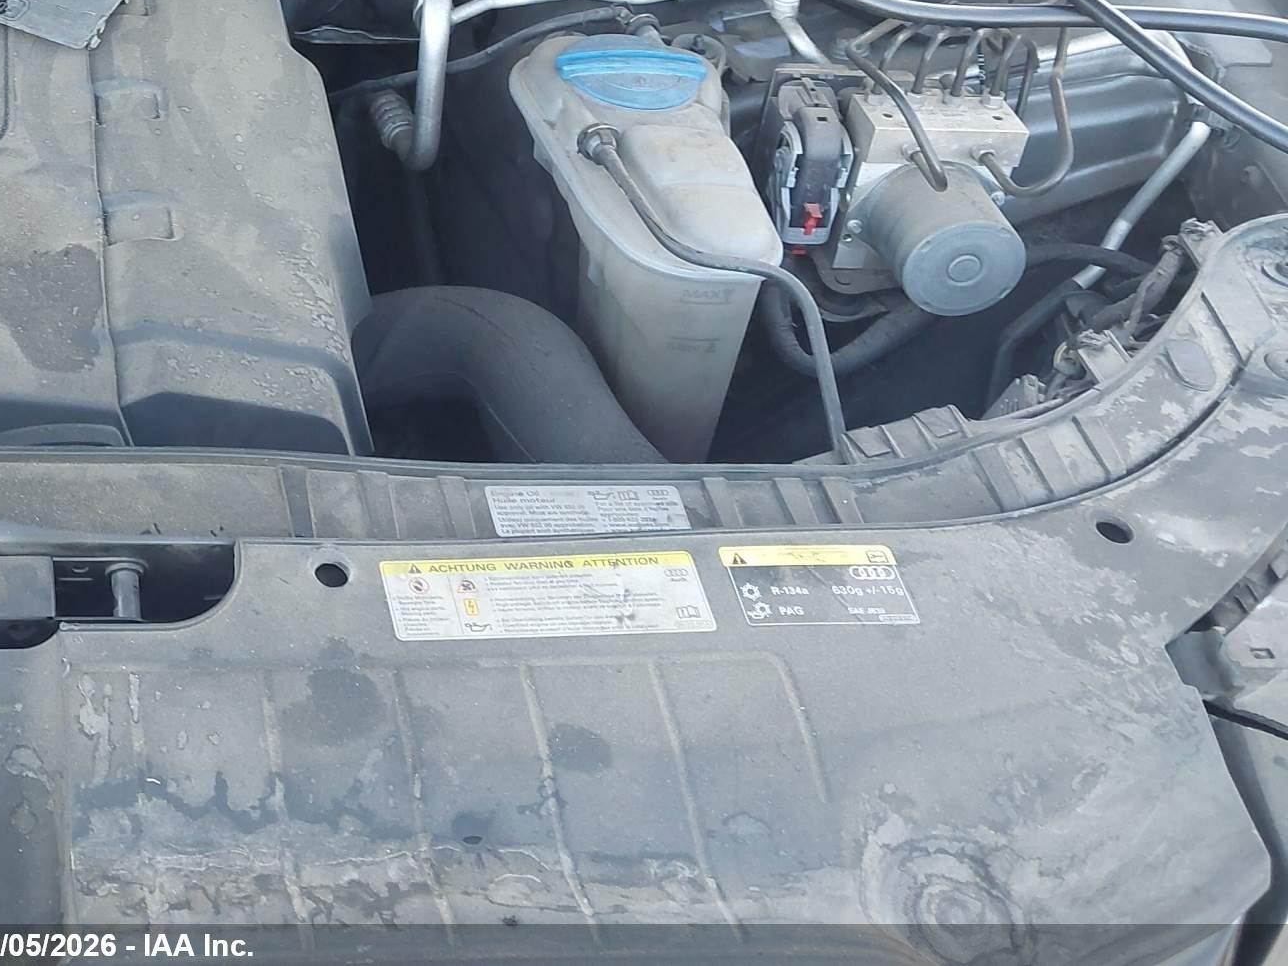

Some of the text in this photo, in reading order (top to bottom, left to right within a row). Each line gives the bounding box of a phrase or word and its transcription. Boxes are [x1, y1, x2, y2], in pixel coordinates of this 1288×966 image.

[428, 556, 659, 573] ACHTUNG WARNING ATTENTION
[770, 586, 810, 595] R-134a
[778, 606, 805, 616] PAG
